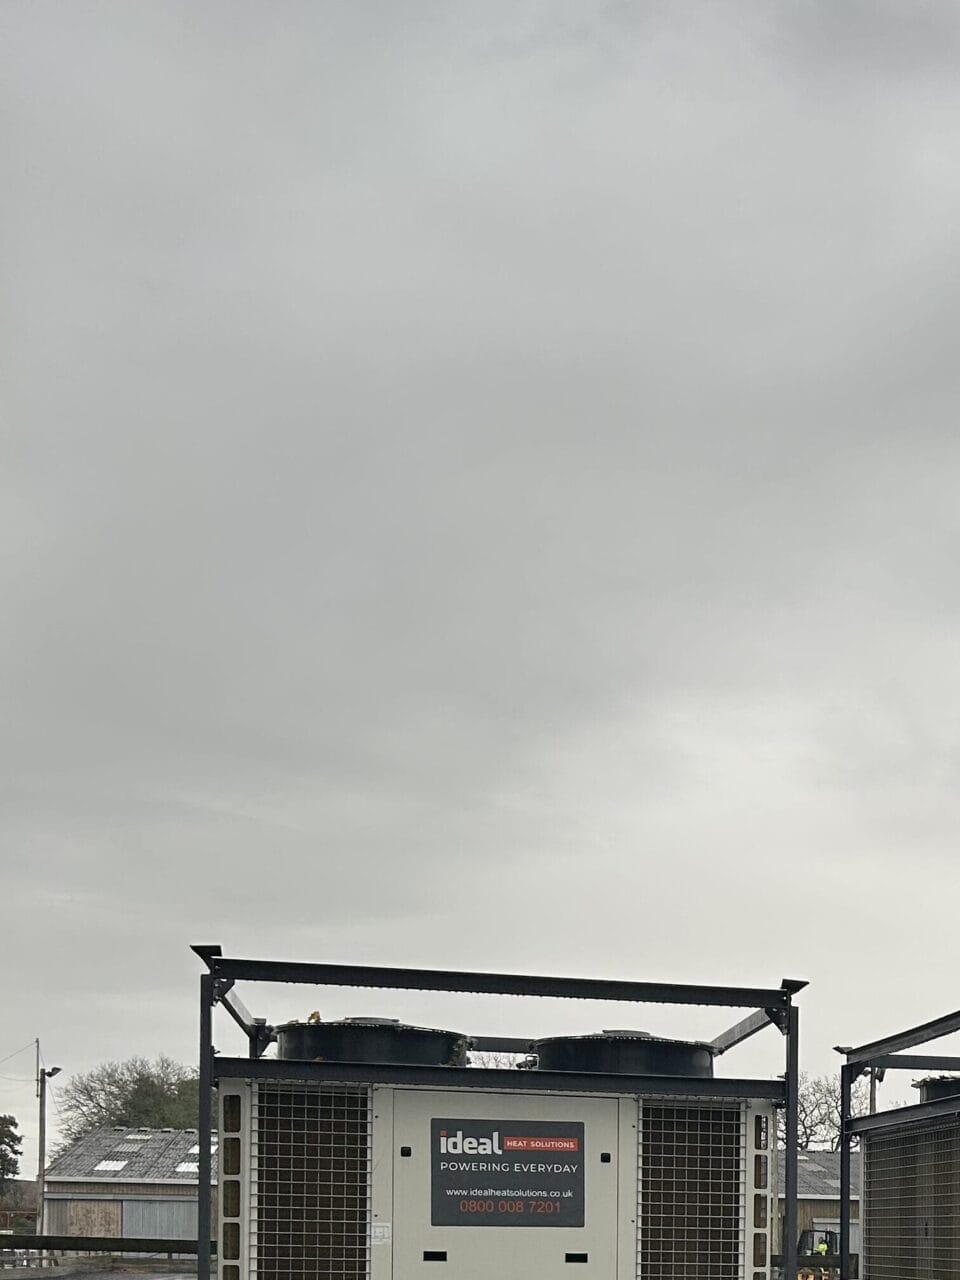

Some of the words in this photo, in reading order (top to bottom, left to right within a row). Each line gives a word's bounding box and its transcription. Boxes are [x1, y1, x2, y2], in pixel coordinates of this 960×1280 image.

[439, 1129, 502, 1155] ideal
[506, 1140, 527, 1148] HEAT
[440, 1162, 510, 1172] POWERING
[514, 1163, 578, 1173] EVERYDAY
[446, 1188, 573, 1198] www.idealheatsolutions.co.uk
[459, 1201, 494, 1213] 0800
[498, 1201, 524, 1213] 008
[529, 1201, 561, 1213] 7201
